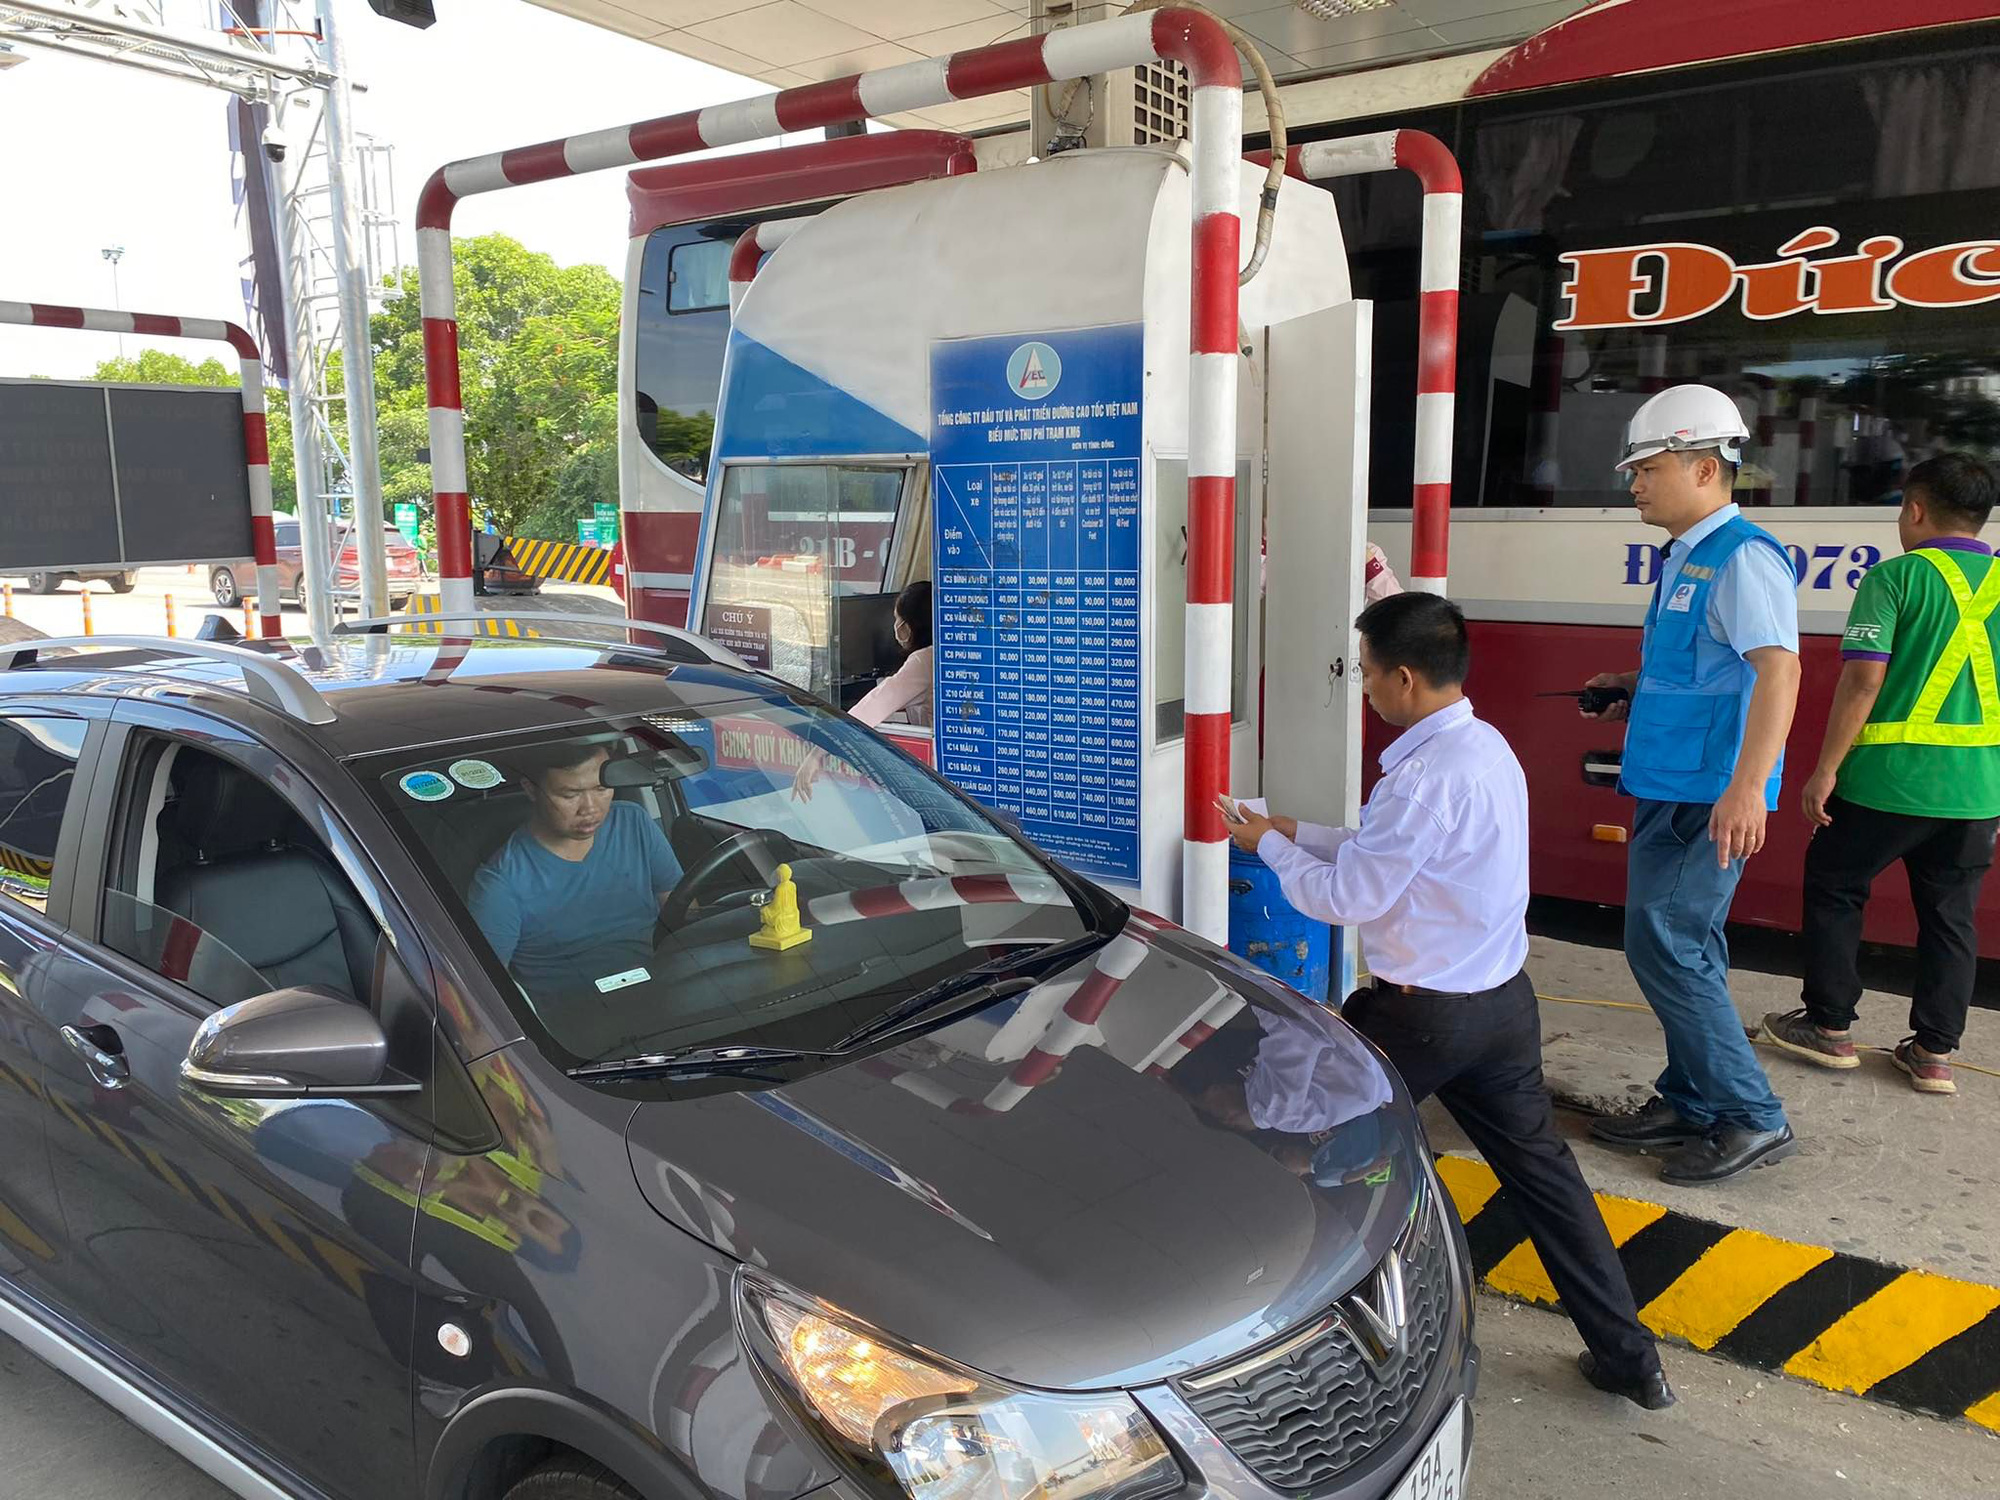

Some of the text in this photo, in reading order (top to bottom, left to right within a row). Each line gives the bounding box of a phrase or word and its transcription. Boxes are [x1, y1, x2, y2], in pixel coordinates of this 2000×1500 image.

[973, 411, 980, 424] TY
[1014, 406, 1031, 421] PHÁT
[1076, 405, 1090, 418] CAO
[1091, 400, 1104, 417] TỐC
[1106, 401, 1120, 419] VIỆT
[1121, 402, 1138, 415] NAM
[1020, 428, 1032, 440] THU
[1033, 425, 1045, 440] PHÍ
[1046, 426, 1064, 442] TRẠM
[967, 480, 983, 494] Loại
[970, 498, 980, 506] xe
[944, 526, 963, 540] Điểm
[947, 544, 961, 555] vào
[722, 610, 754, 625] CHÚ Ý
[722, 726, 751, 759] CHÚC
[754, 730, 775, 763] QUÝ
